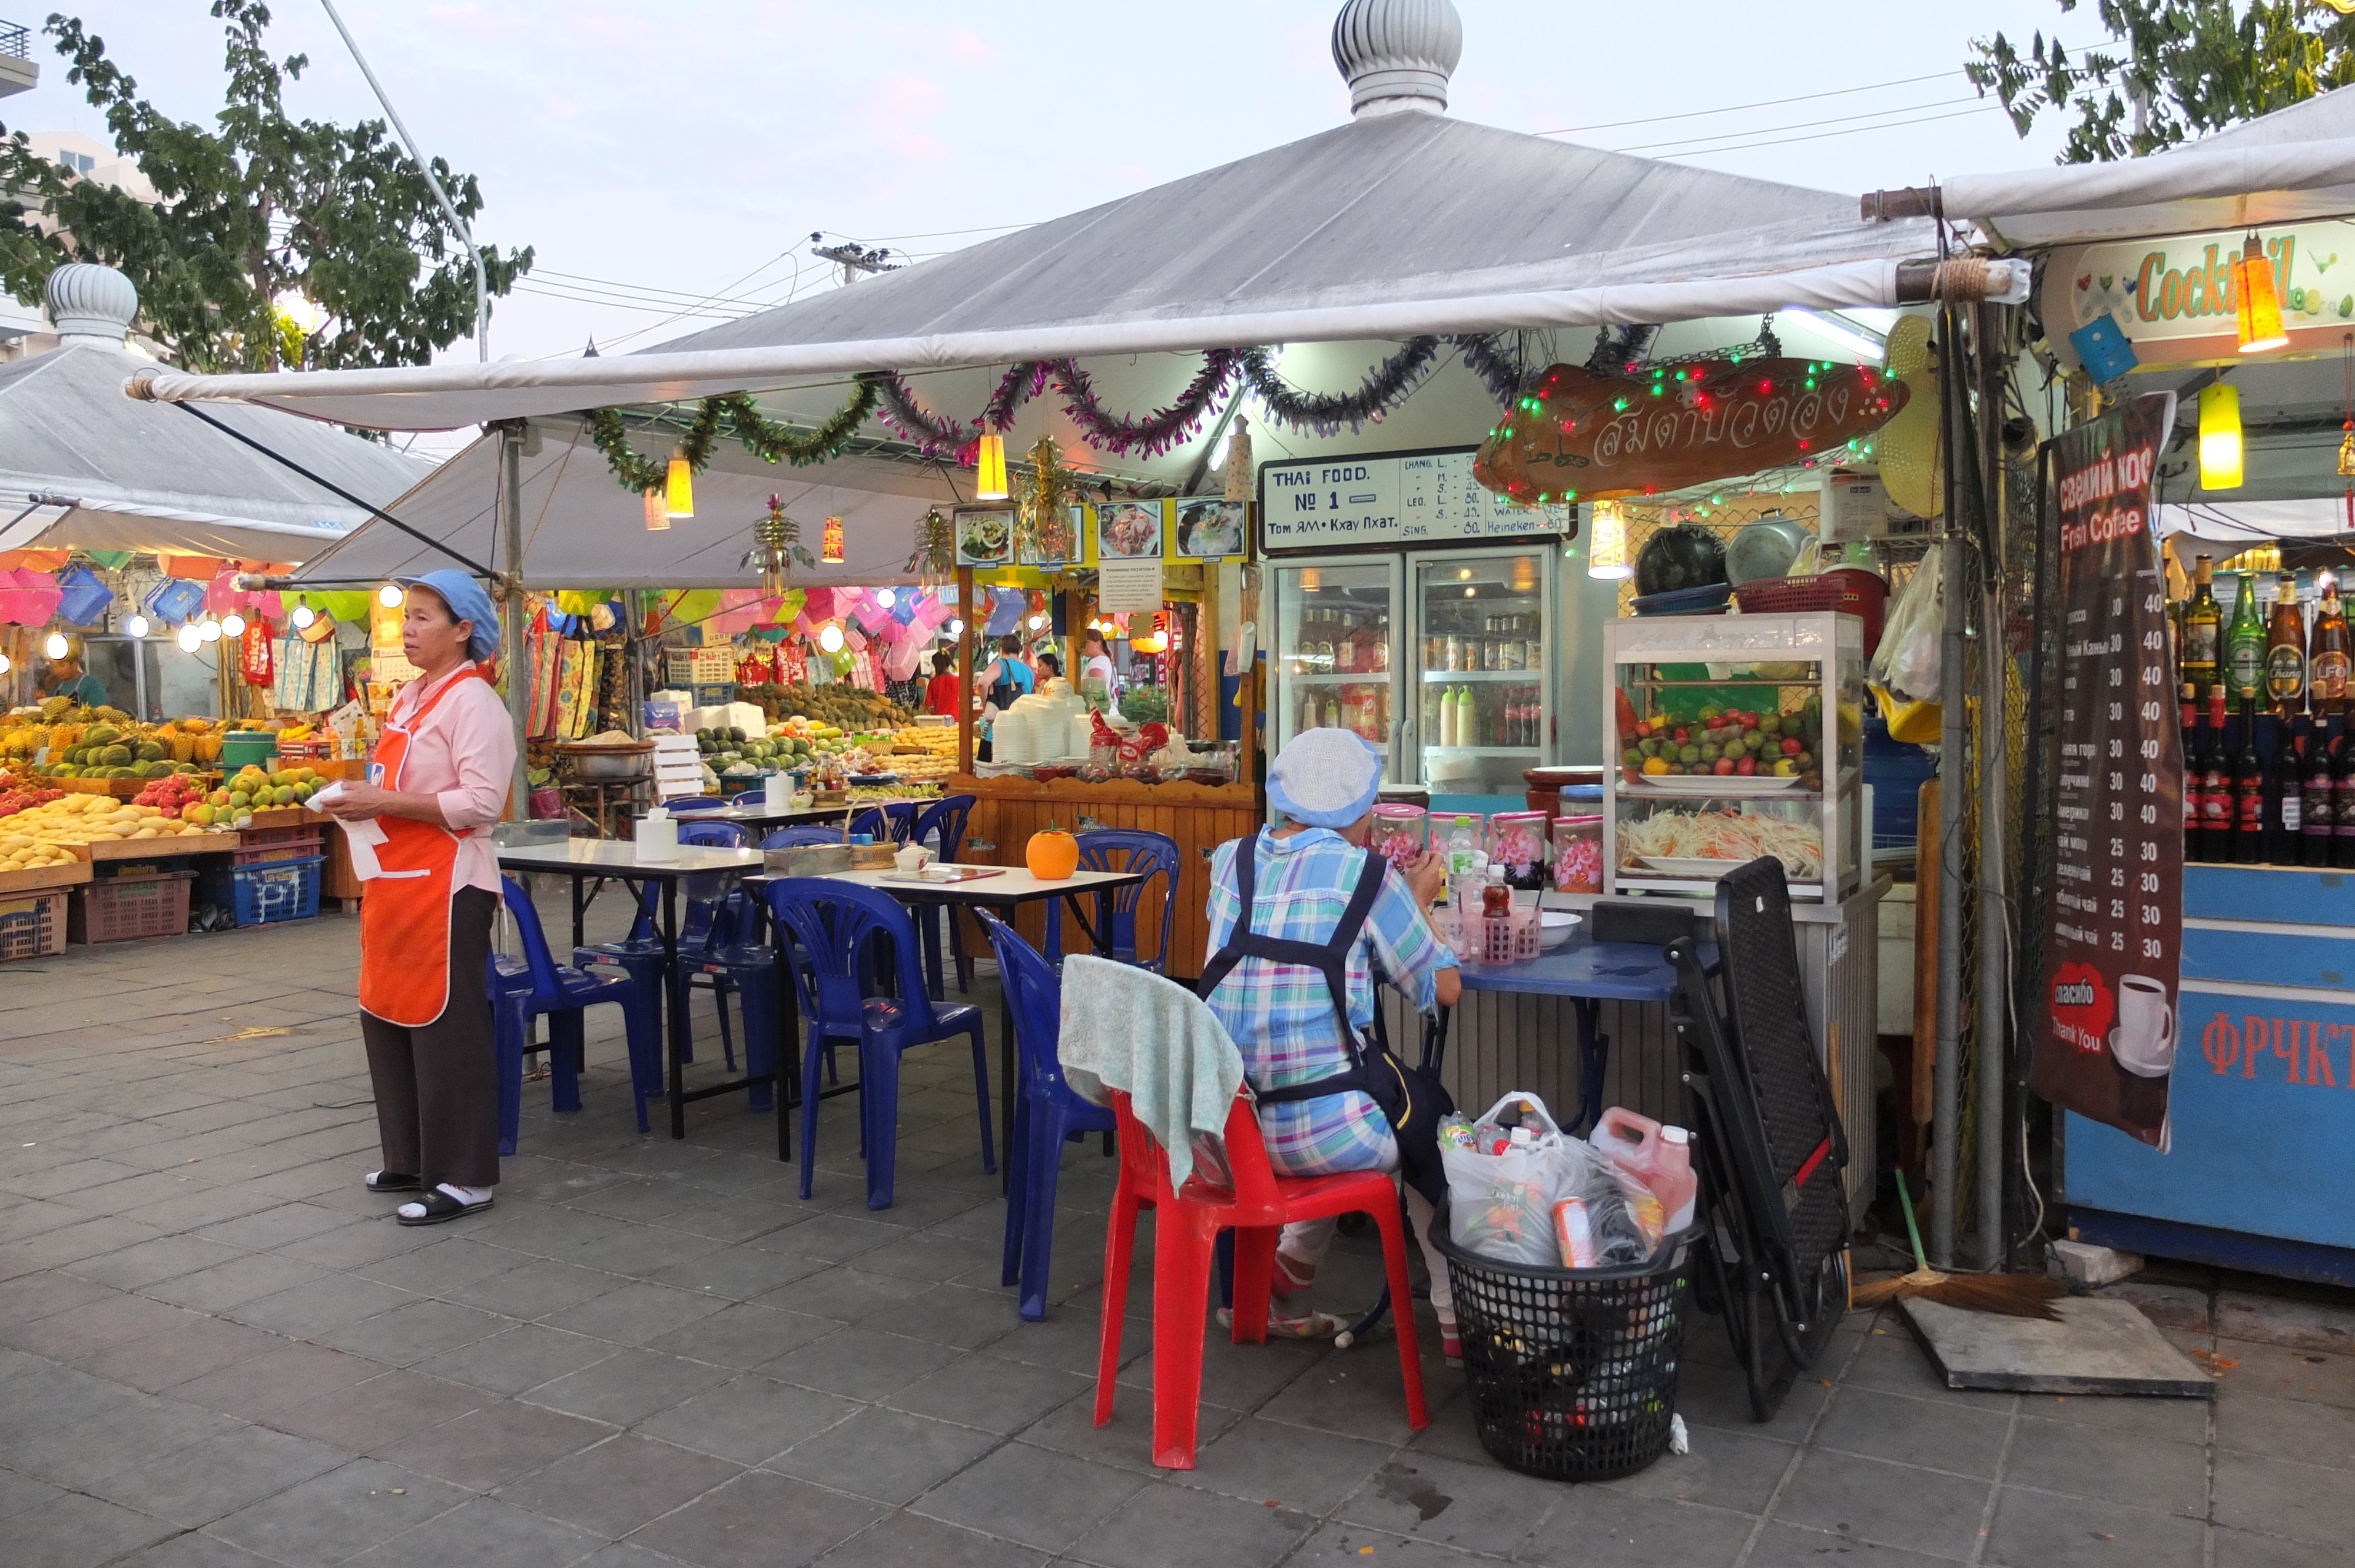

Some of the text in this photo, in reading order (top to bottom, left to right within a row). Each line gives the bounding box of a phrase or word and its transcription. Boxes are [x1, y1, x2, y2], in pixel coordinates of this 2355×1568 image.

[2136, 235, 2296, 322] Cocktil
[1322, 467, 1370, 484] FOOD.
[1329, 491, 1339, 509] 1
[2144, 594, 2162, 613] 40
[2143, 631, 2162, 650] 40
[2109, 668, 2122, 686] 30
[2142, 666, 2161, 685] 40
[2109, 702, 2122, 721] 30
[2141, 702, 2160, 720] 40
[2109, 739, 2122, 758] 30
[2140, 740, 2158, 759] 40
[2109, 772, 2123, 790] 30
[2140, 773, 2157, 793] 40
[2110, 802, 2124, 820] 30
[2140, 804, 2157, 824] 40
[2111, 838, 2123, 856] 25
[2141, 842, 2157, 862] 30
[2111, 868, 2124, 887] 25
[2141, 872, 2159, 893] 30
[2111, 899, 2124, 918] 25
[2141, 905, 2161, 925] 30
[2111, 931, 2124, 951] 25
[2142, 938, 2161, 959] 30
[2052, 1016, 2101, 1051] Thank You
